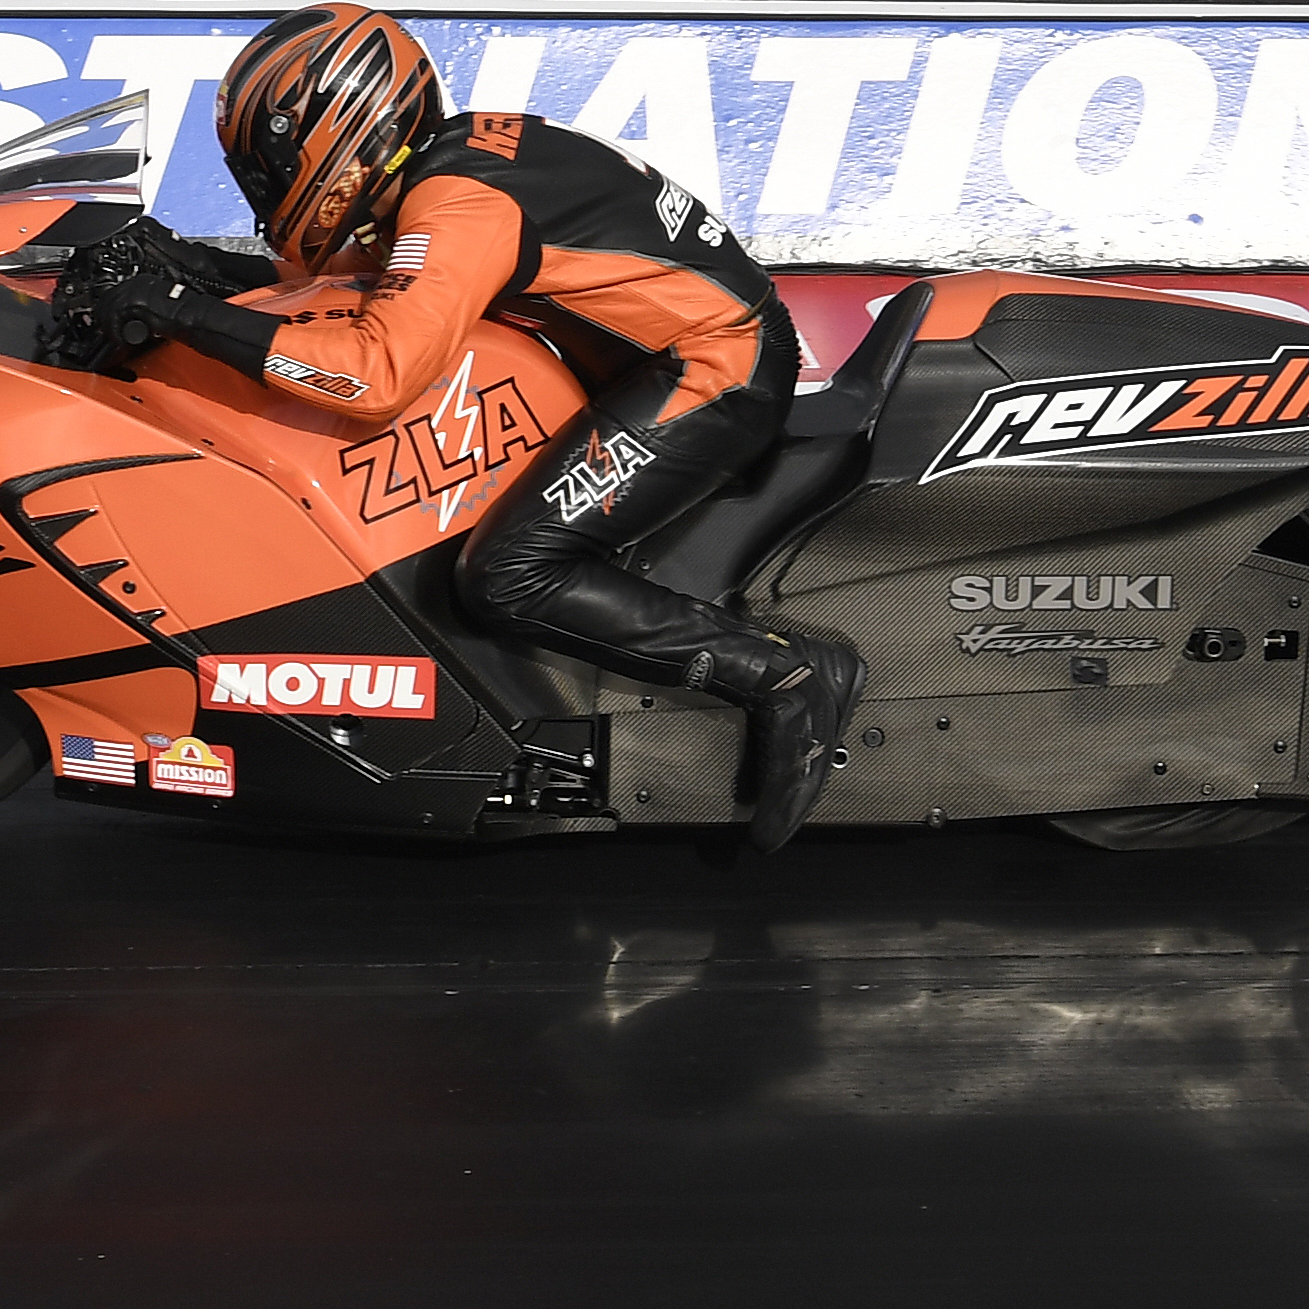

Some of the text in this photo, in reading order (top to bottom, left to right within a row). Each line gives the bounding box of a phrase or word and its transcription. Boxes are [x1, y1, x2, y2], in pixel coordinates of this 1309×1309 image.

[264, 357, 363, 398] revzilla
[341, 378, 552, 523] ZLA
[544, 431, 656, 522] ZLA
[949, 575, 1176, 611] SUZUKI
[956, 624, 1163, 658] Hayabusa
[210, 659, 428, 710] MOTUL
[157, 763, 227, 784] MISSION
